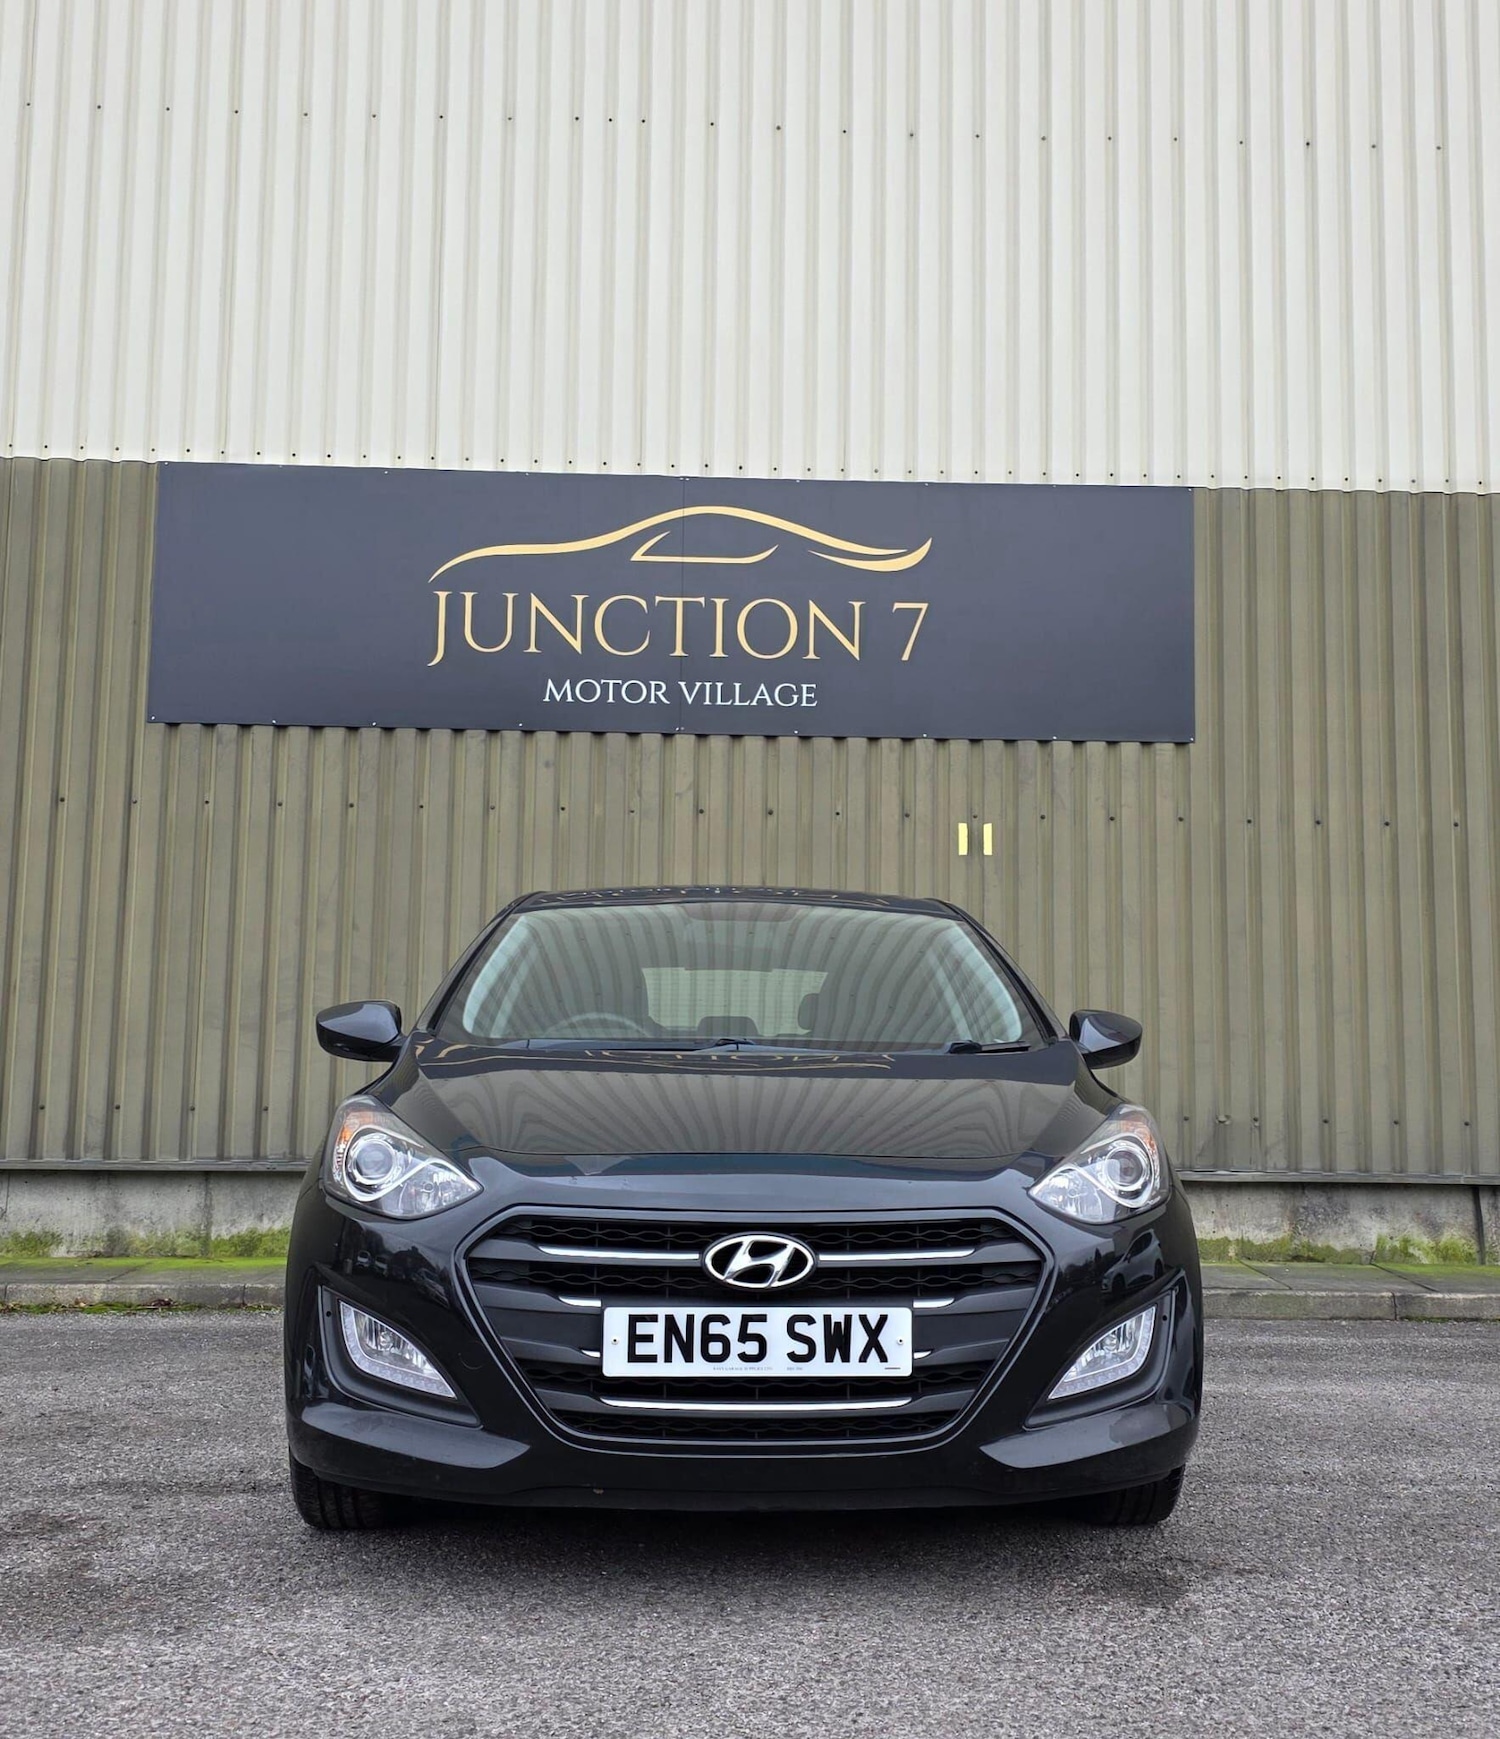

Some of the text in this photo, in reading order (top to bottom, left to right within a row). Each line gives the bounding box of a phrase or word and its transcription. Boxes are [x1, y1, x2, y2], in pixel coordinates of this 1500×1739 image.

[427, 591, 929, 666] JUNCTION 7
[543, 679, 818, 707] MOTOR VILLAGE
[627, 1314, 889, 1363] EN65 SWX
